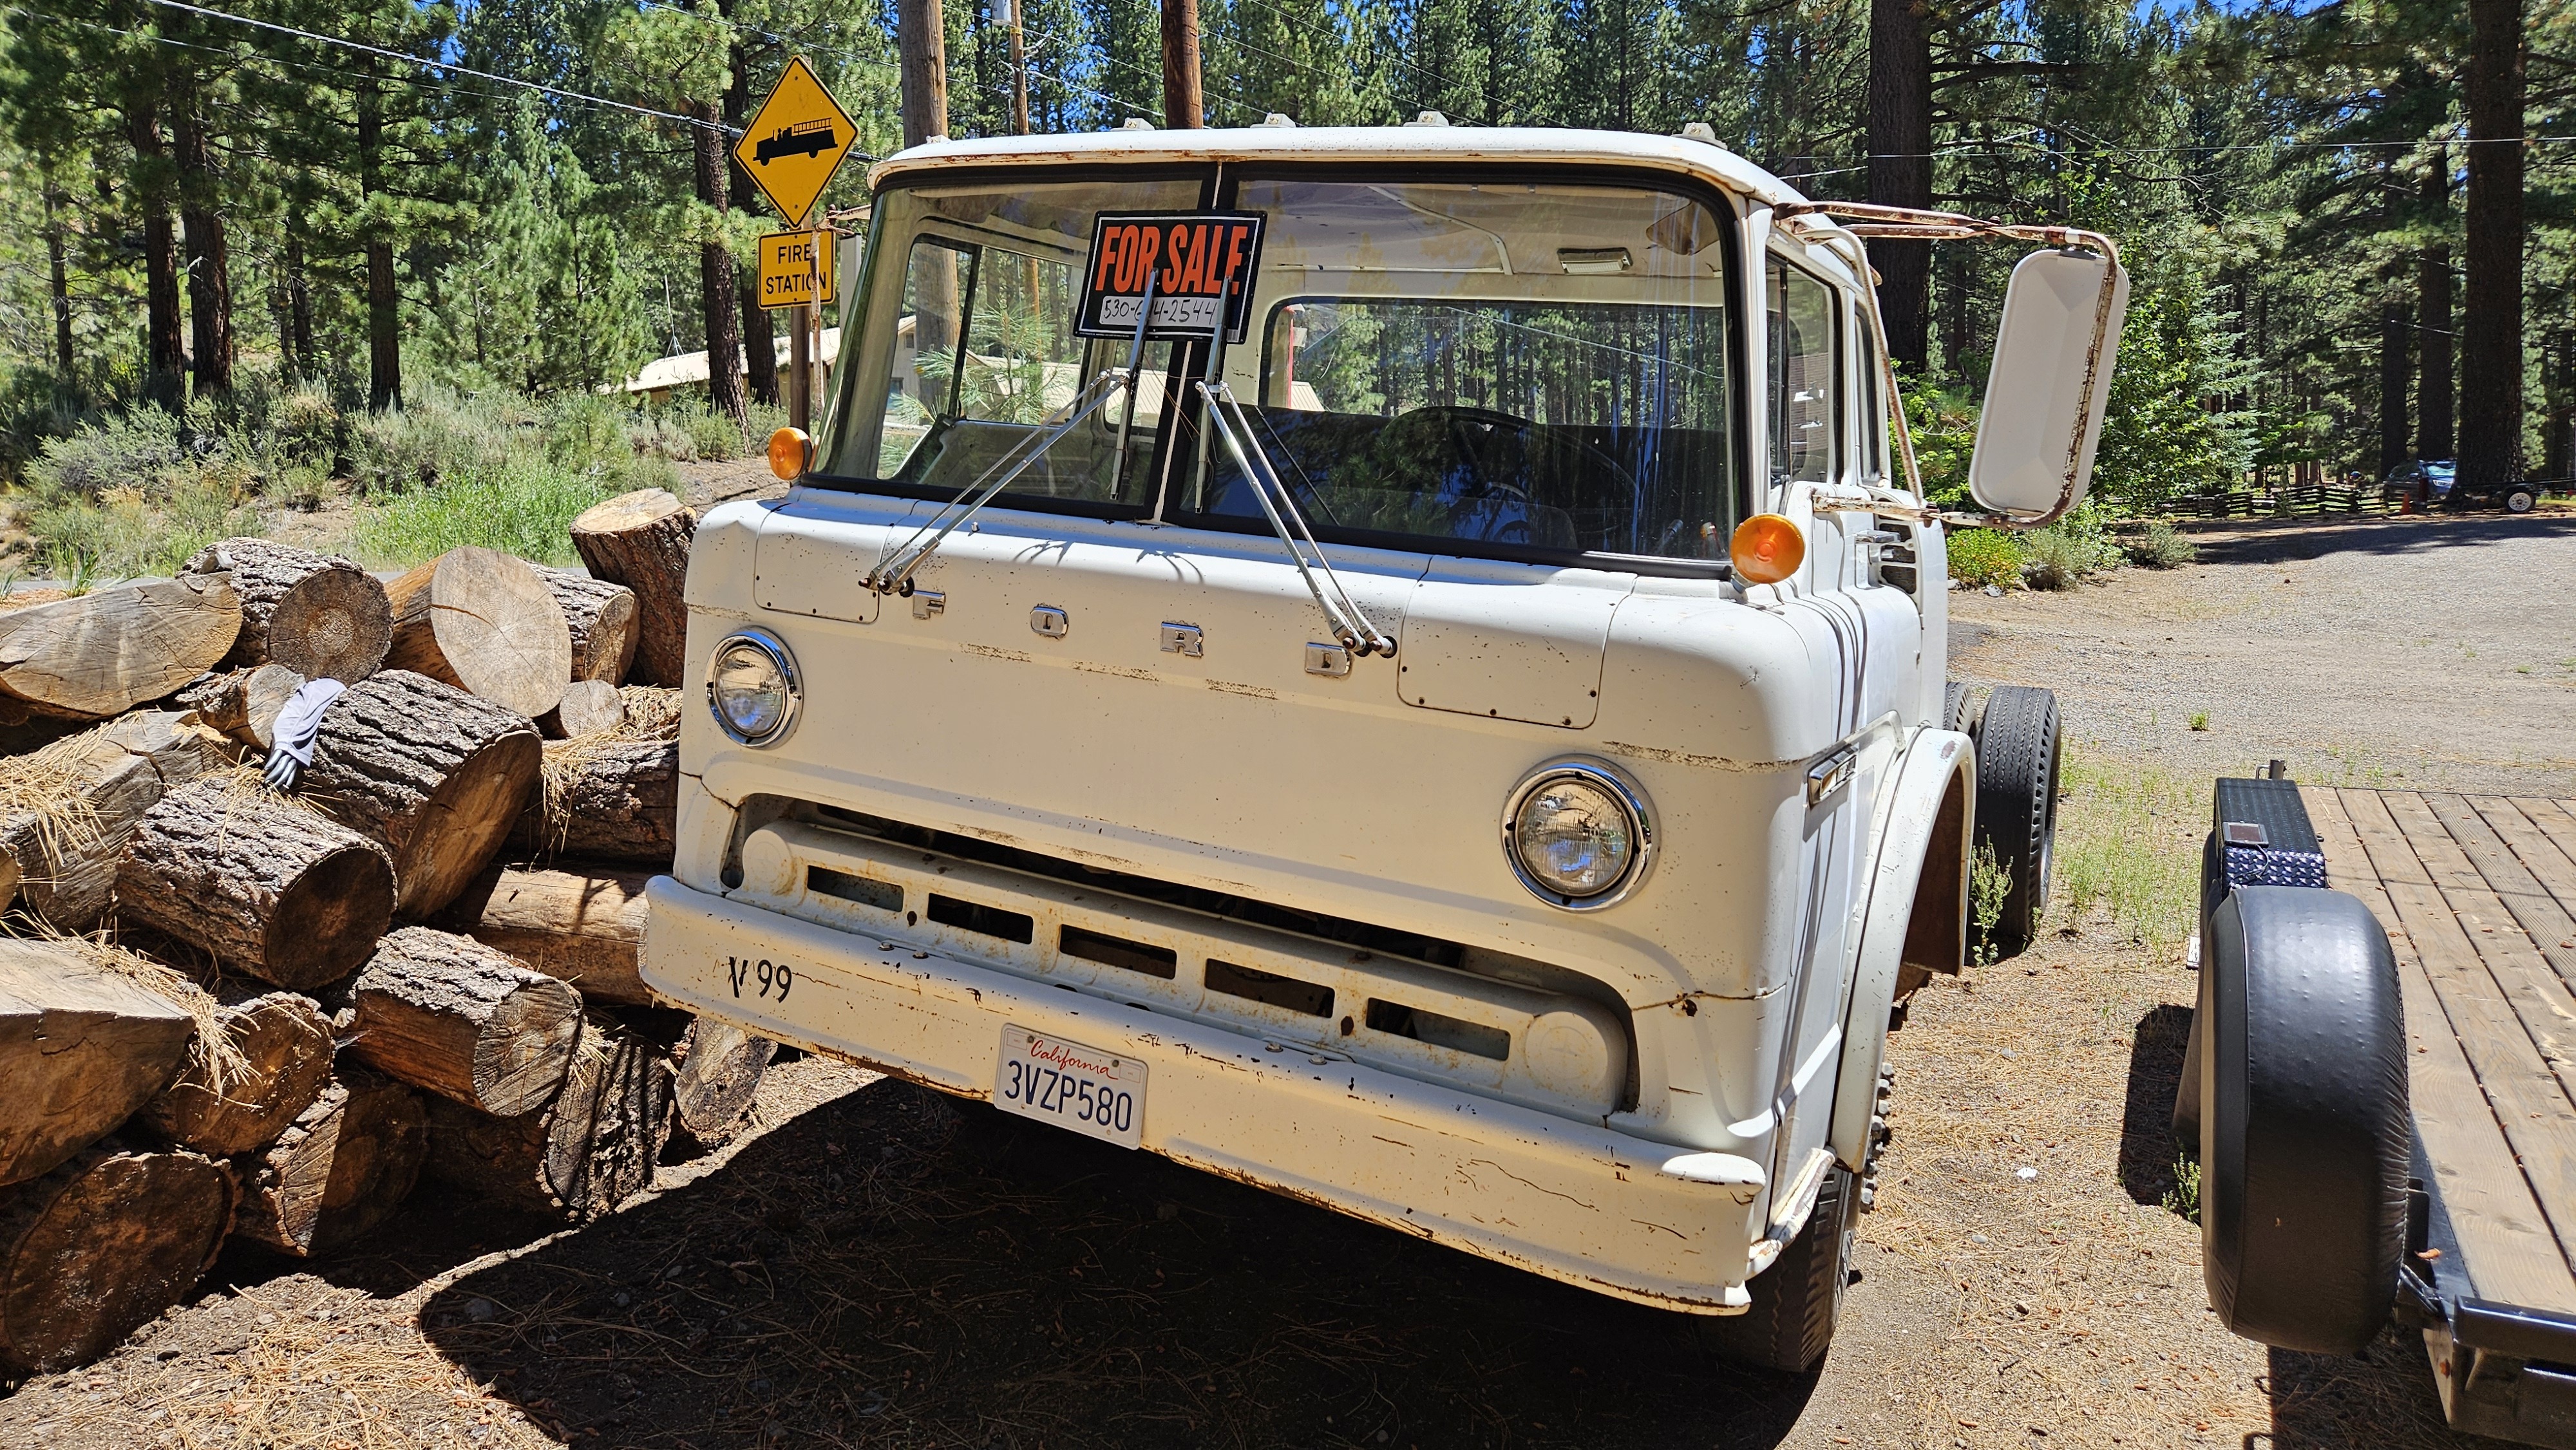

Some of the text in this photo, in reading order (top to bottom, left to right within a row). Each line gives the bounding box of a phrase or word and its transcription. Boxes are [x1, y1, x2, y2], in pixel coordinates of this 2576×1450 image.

[778, 243, 811, 264] FIRE
[1095, 223, 1248, 295] FOR SALE
[1103, 299, 1218, 325] 530-64-2544
[913, 590, 1350, 676] FORD
[1030, 1039, 1119, 1080] California
[1005, 1060, 1133, 1132] 3VZP580
